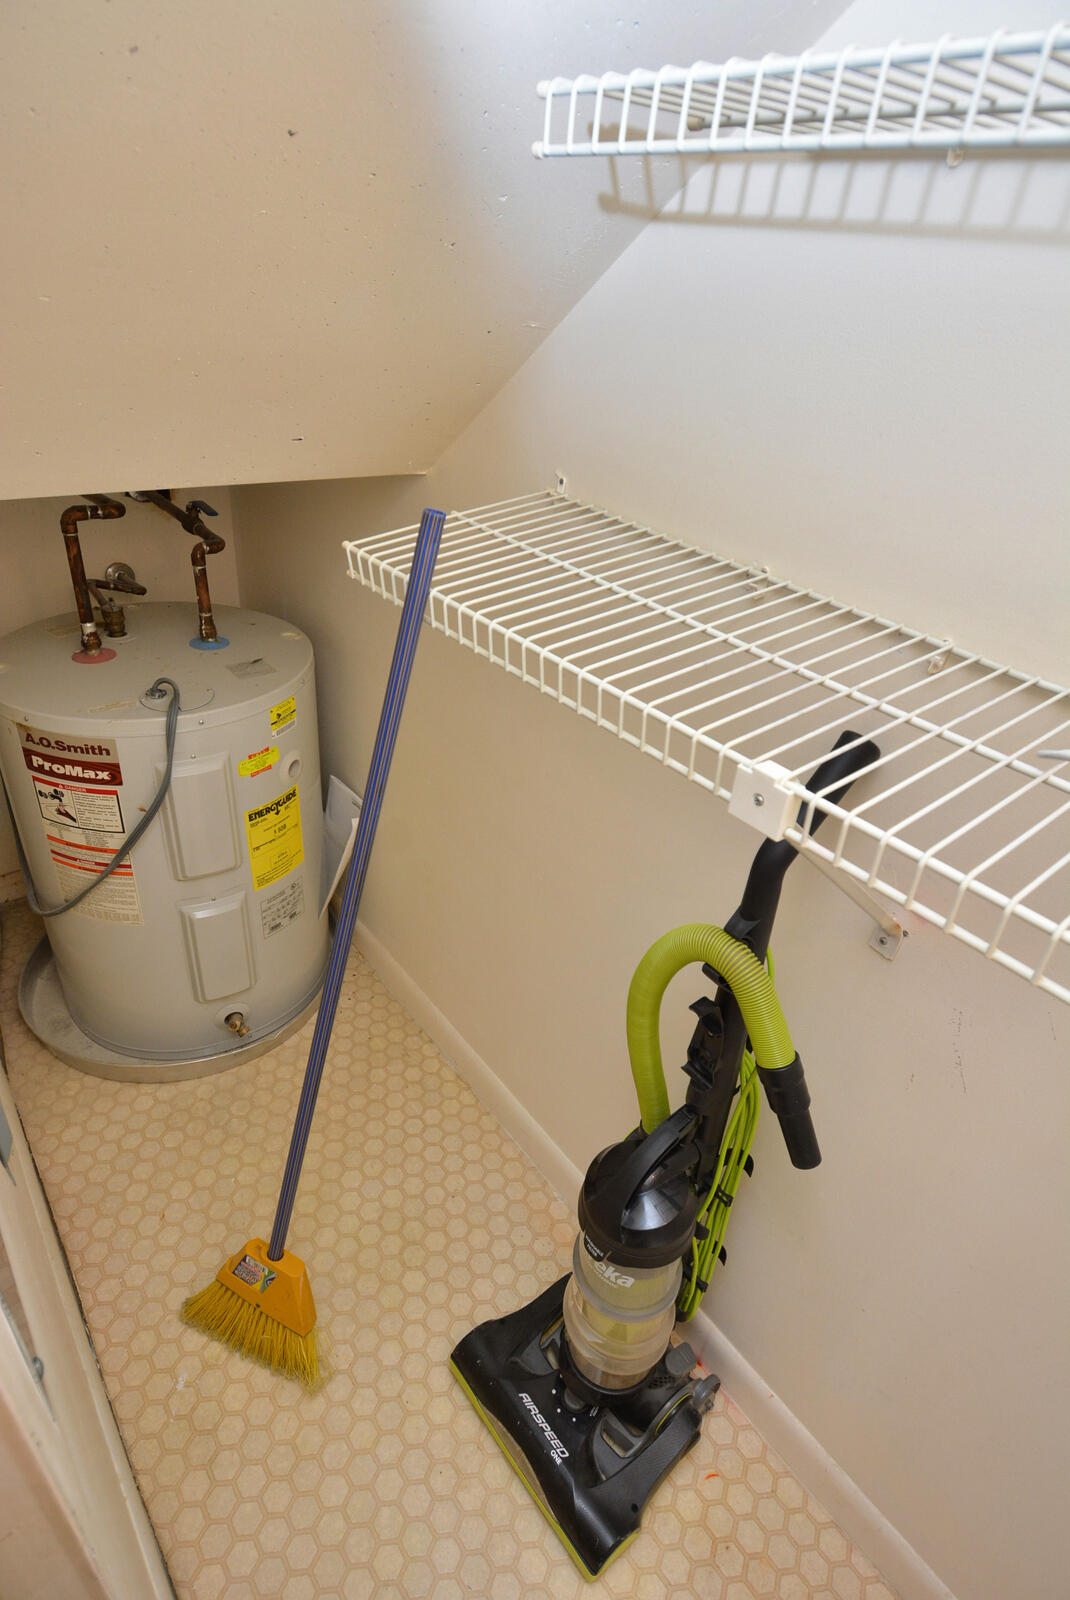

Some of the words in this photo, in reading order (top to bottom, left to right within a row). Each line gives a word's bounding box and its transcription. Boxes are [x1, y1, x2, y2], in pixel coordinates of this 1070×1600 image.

[31, 755, 111, 780] ProMax
[519, 1393, 569, 1458] AIRSPEED
[550, 1449, 563, 1466] ONE
